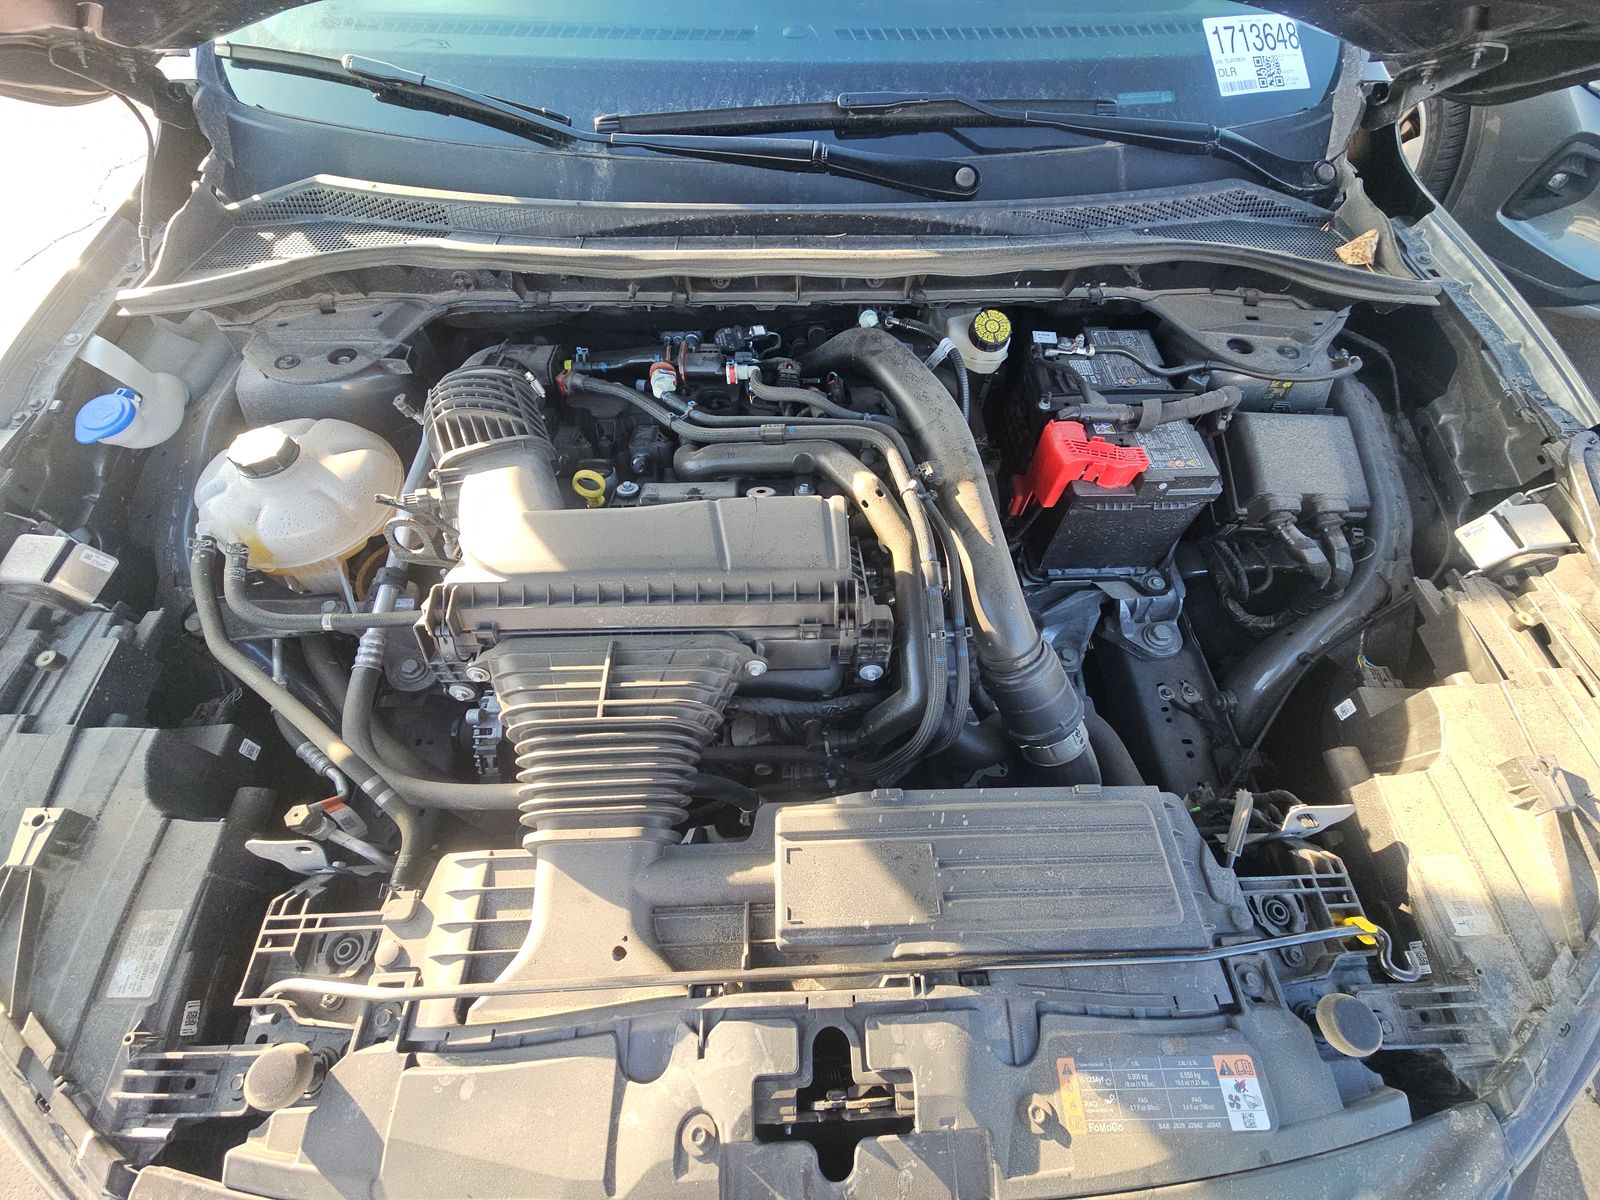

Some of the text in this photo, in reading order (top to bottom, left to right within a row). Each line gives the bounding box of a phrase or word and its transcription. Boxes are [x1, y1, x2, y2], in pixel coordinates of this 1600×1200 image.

[1213, 22, 1300, 54] 1713648
[1218, 67, 1237, 77] DLR
[1142, 1073, 1149, 1081] kg
[1194, 1072, 1201, 1080] kg
[1089, 1123, 1124, 1132] FoMoCo
